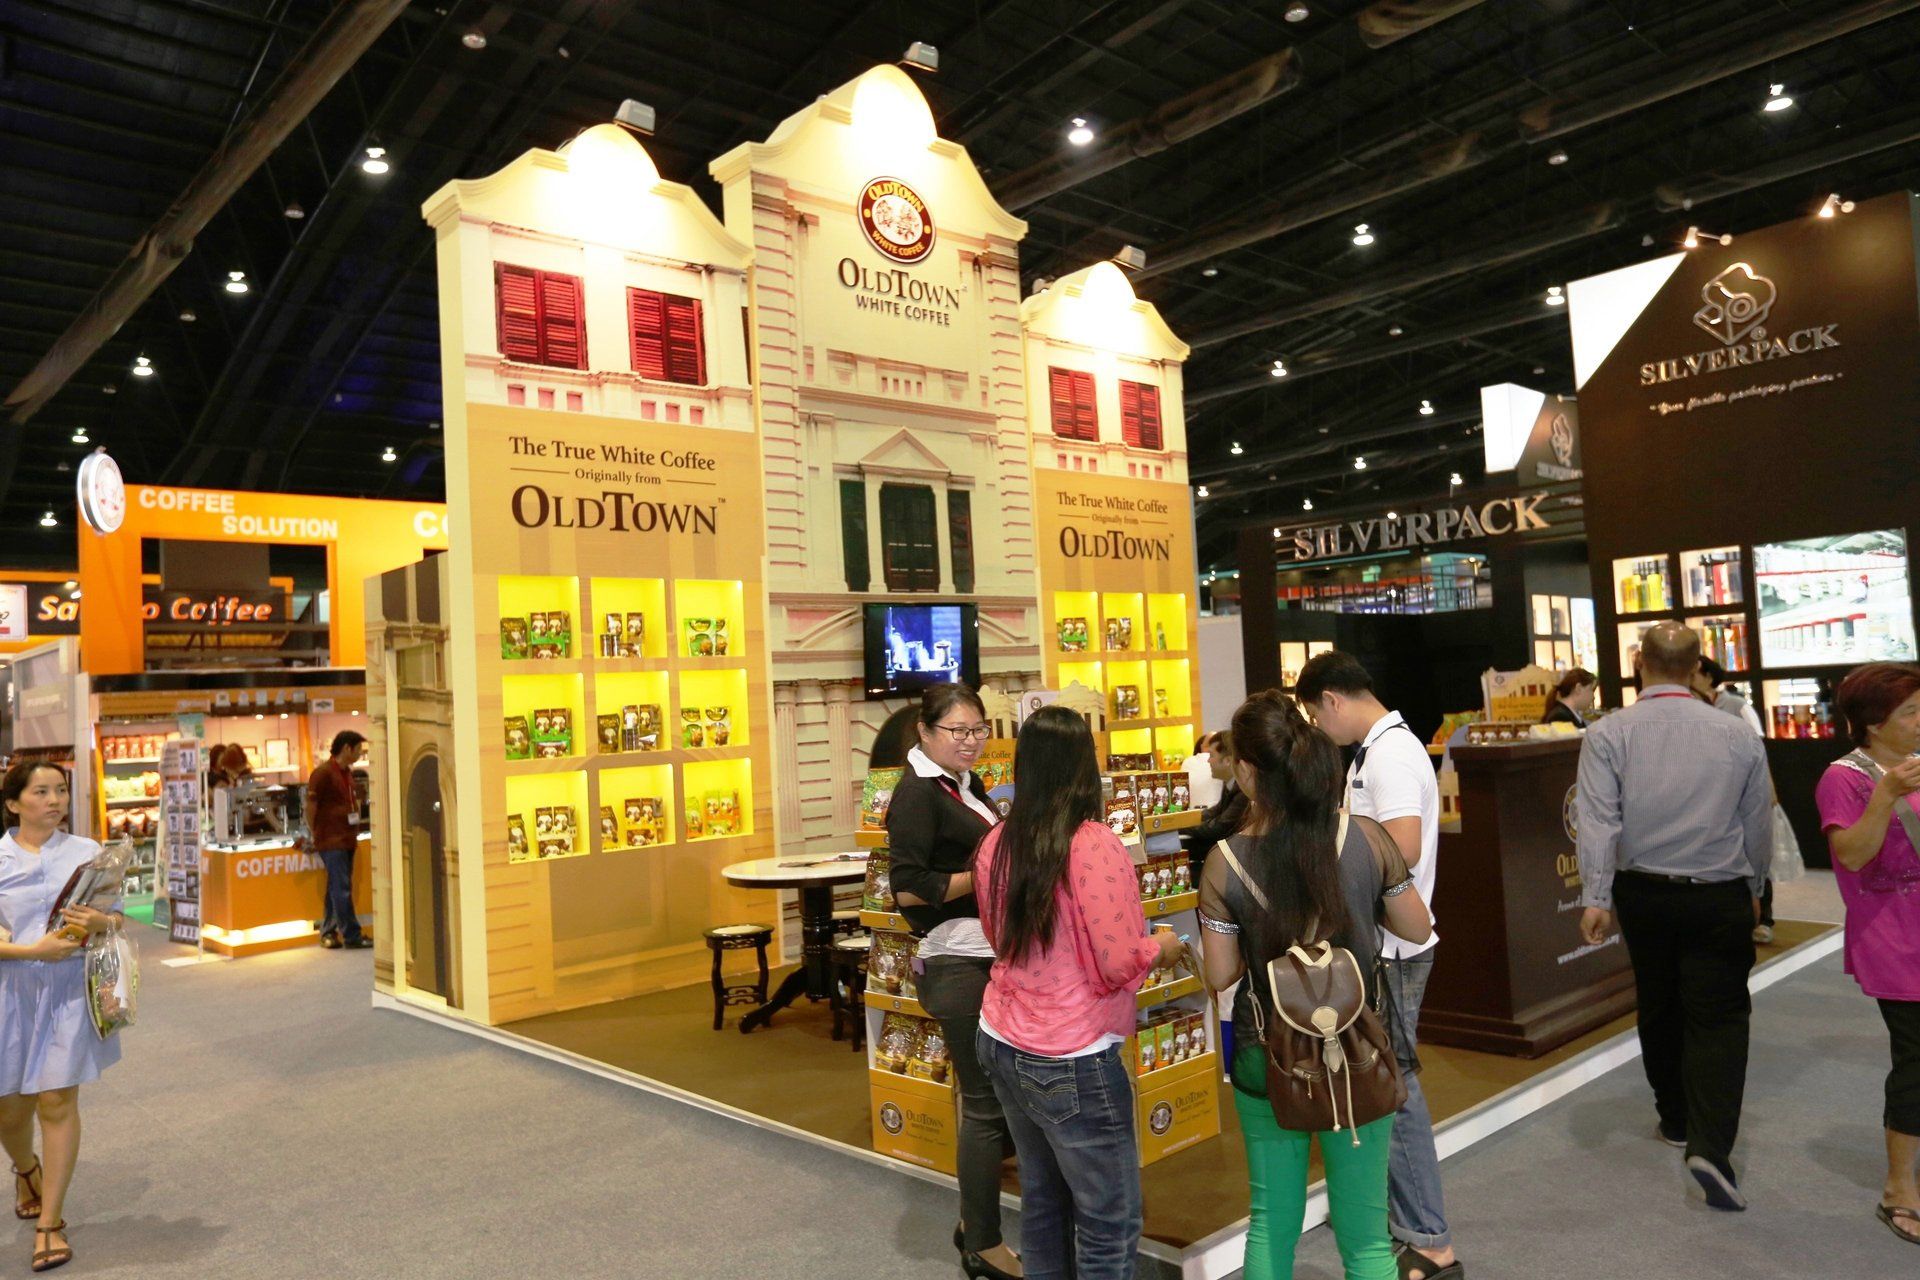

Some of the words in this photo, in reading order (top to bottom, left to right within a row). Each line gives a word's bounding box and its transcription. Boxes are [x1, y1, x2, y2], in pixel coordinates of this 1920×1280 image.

[868, 181, 924, 213] OLDTOWN
[872, 230, 898, 254] WHITE
[899, 242, 925, 256] COFFEE
[838, 257, 960, 311] OLDTOWN
[856, 294, 900, 316] WHITE
[905, 305, 950, 327] COFFEE
[1640, 323, 1841, 386] SILVERPACK
[509, 436, 547, 457] The
[552, 440, 596, 461] True
[600, 445, 656, 466] White
[660, 450, 716, 471] Coffee
[575, 468, 632, 485] Originally
[635, 471, 661, 485] from
[139, 488, 235, 514] COFFEE
[511, 485, 718, 535] OLDTOWN
[1057, 491, 1077, 506] The
[1079, 493, 1103, 509] True
[1105, 496, 1135, 511] White
[1137, 499, 1168, 514] Coffee
[222, 515, 338, 538] SOLUTION
[1293, 491, 1551, 562] SILVERPACK
[1060, 526, 1170, 561] OLDTOWN
[170, 596, 273, 626] Coffee
[1556, 854, 1578, 877] OLD
